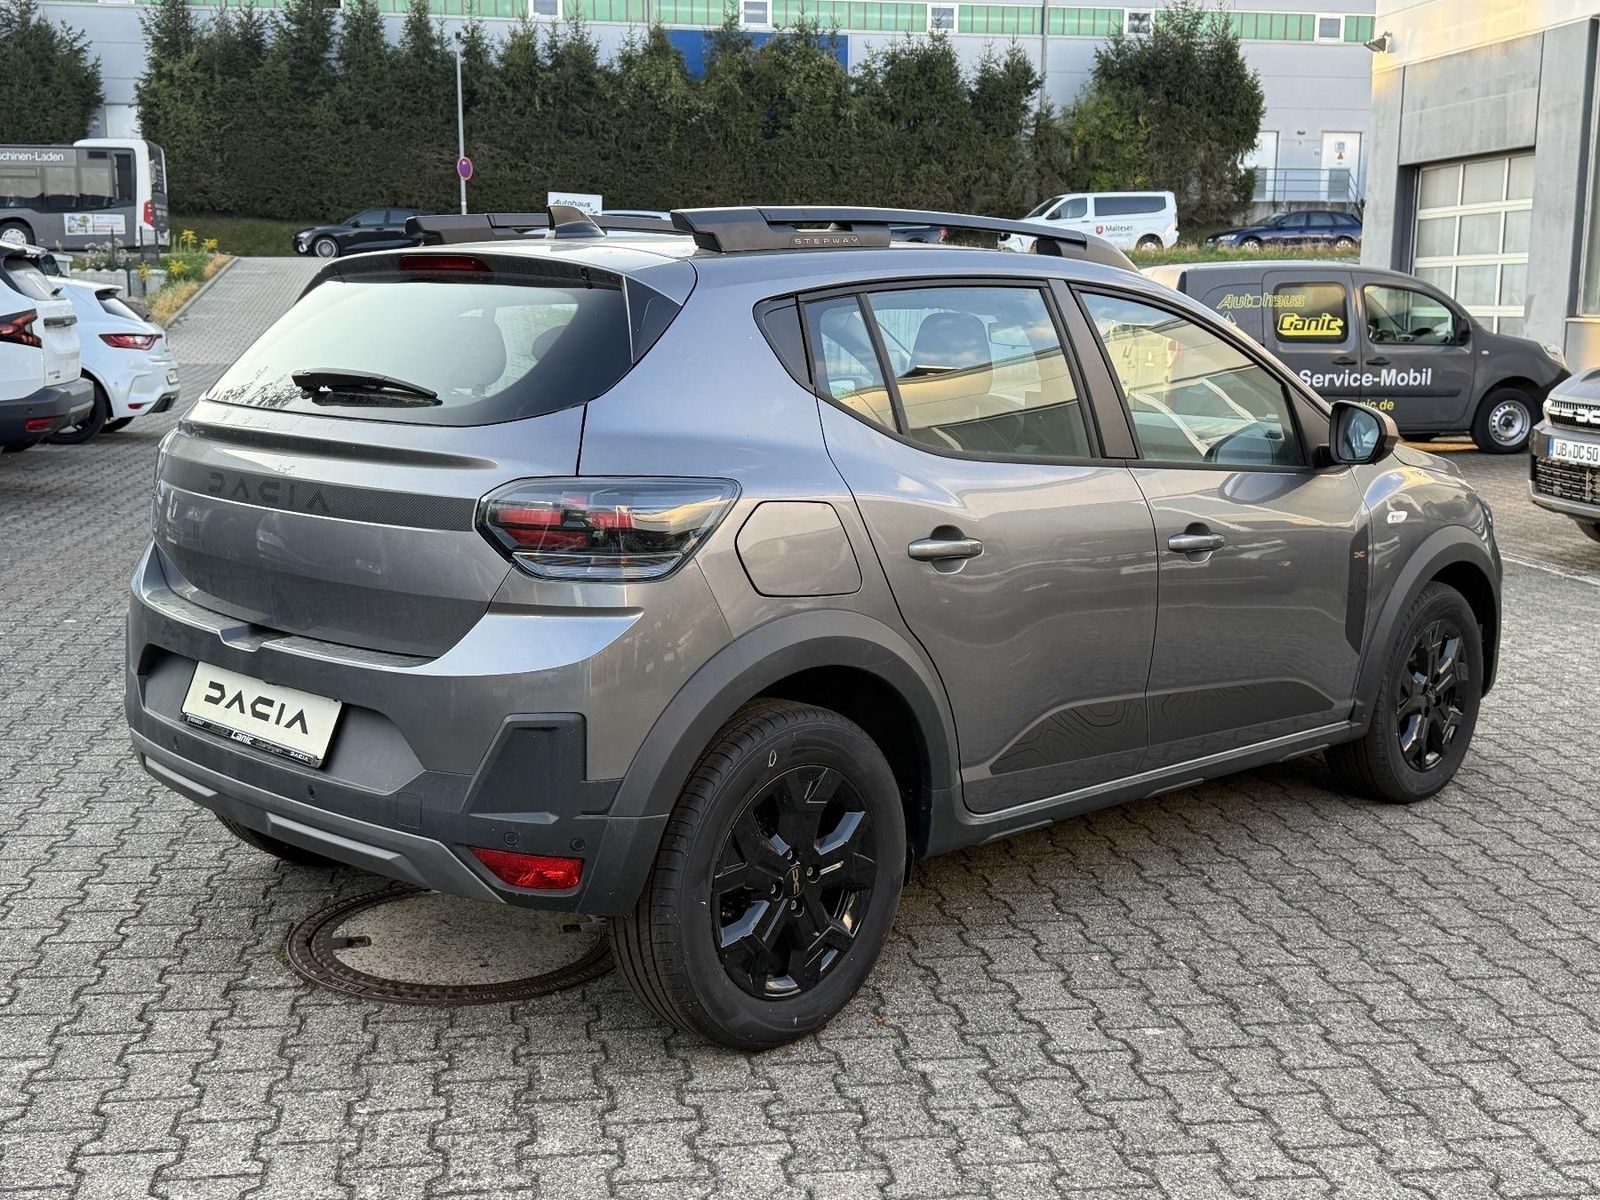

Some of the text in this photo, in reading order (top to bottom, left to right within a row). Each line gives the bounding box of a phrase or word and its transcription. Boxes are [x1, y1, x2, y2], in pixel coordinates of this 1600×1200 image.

[553, 199, 591, 208] Autohaus
[1105, 224, 1133, 232] Malteser
[794, 236, 858, 245] STEPWAY
[1216, 292, 1306, 309] Autohaus
[1278, 313, 1343, 335] Canic
[1299, 368, 1432, 387] Service-Mobil
[1573, 444, 1585, 459] DC
[208, 471, 331, 513] DACIA
[203, 680, 309, 735] DACIA
